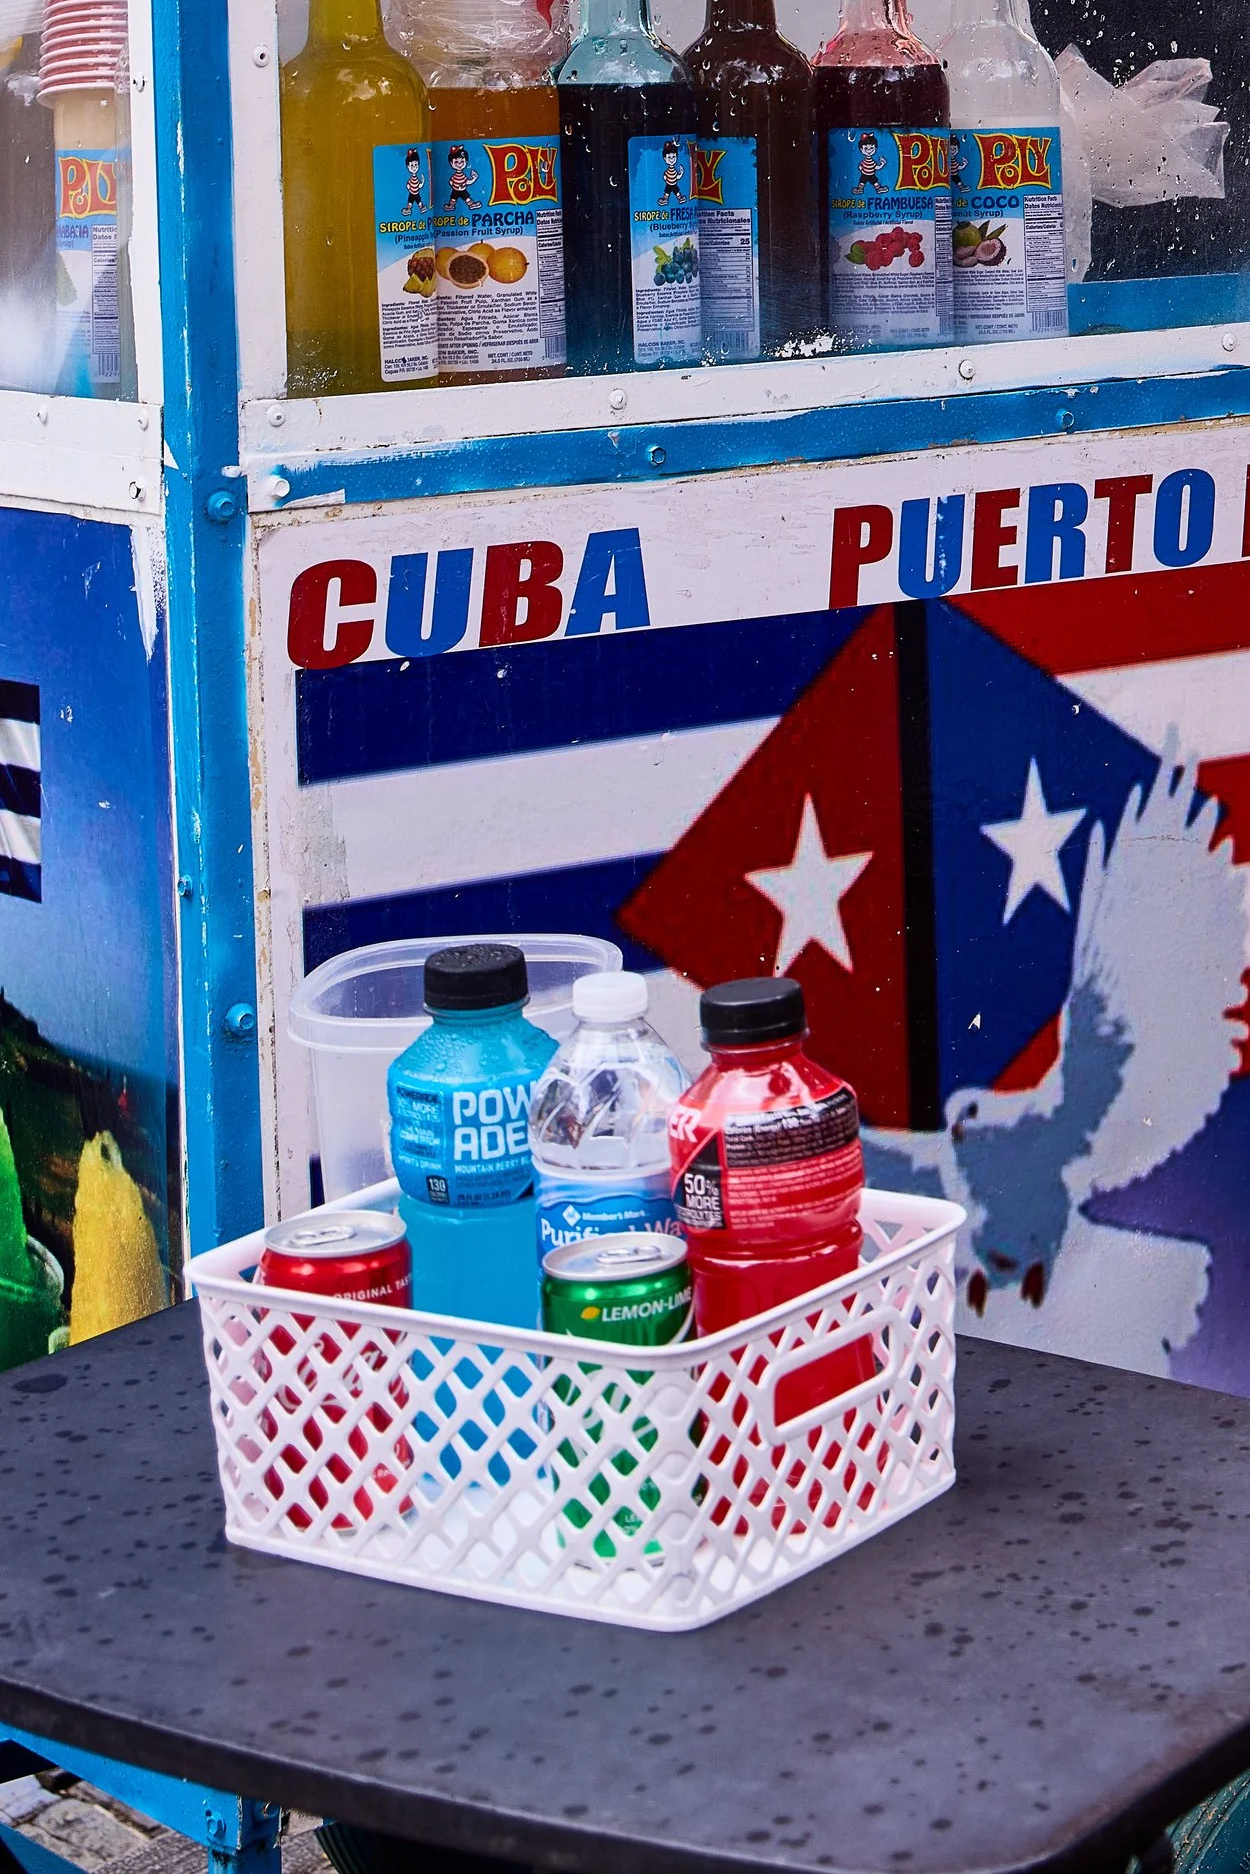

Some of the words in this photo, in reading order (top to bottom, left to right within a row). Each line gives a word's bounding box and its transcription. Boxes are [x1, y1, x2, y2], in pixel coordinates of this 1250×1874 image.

[866, 196, 934, 211] FRAMBUESA
[970, 195, 1021, 210] COCO
[457, 215, 469, 227] de
[471, 211, 535, 227] PARCHA
[894, 210, 924, 220] Syrup)
[379, 220, 417, 234] SIROPE
[434, 228, 470, 240] (Passion
[471, 226, 493, 237] Fruit
[494, 226, 524, 236] Syrup)
[828, 468, 1216, 611] PUERTO
[286, 527, 653, 672] CUBA
[454, 1162, 495, 1174] MOUNTAIN
[428, 1177, 447, 1193] 130
[683, 1173, 720, 1196] 50%
[685, 1194, 721, 1211] MORE
[601, 1286, 693, 1322] LEMON-LIME
